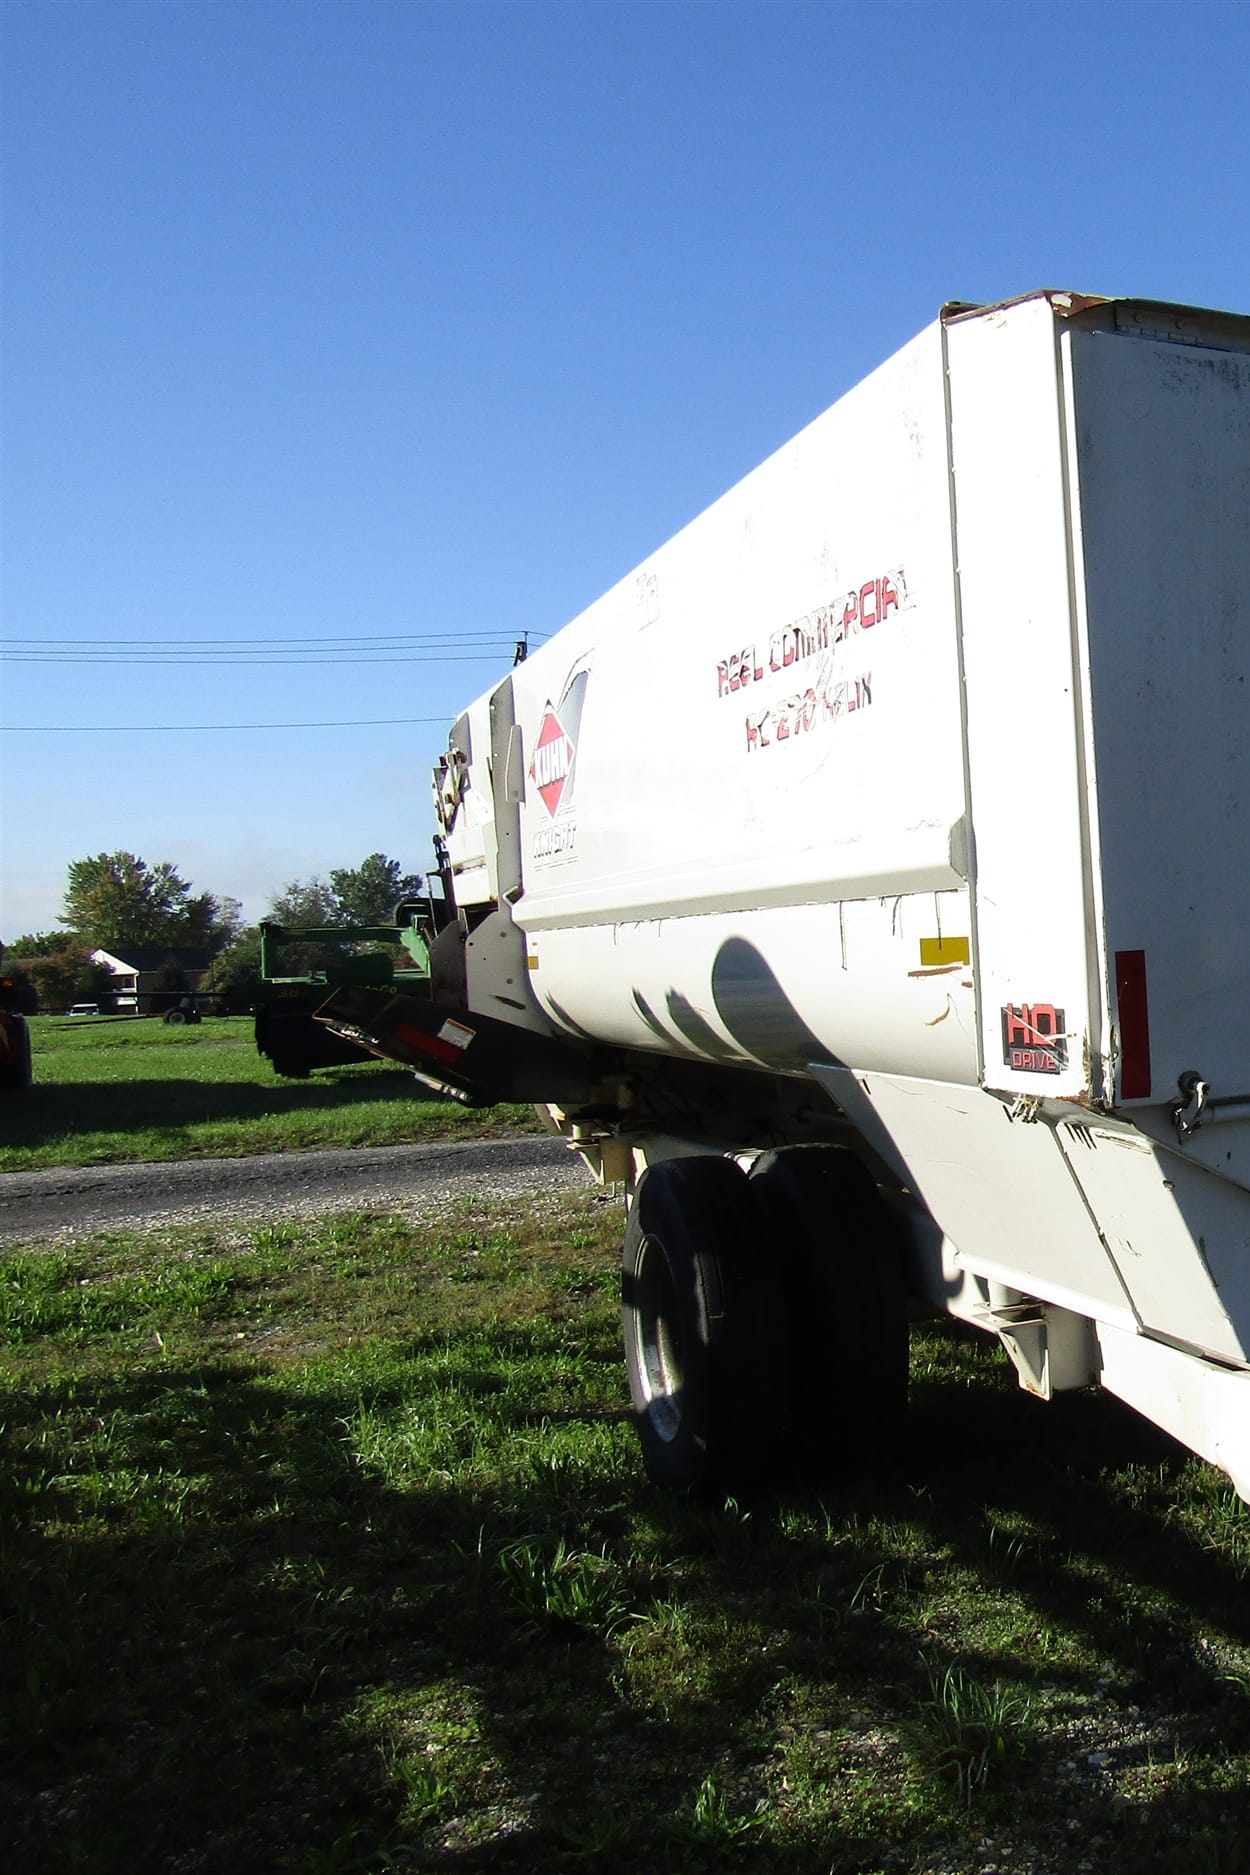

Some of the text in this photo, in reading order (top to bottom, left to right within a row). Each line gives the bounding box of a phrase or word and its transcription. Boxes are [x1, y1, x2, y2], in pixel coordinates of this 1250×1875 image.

[534, 733, 569, 790] KUHN
[533, 819, 578, 860] KNIGHT
[1012, 1050, 1057, 1071] DRIVE
